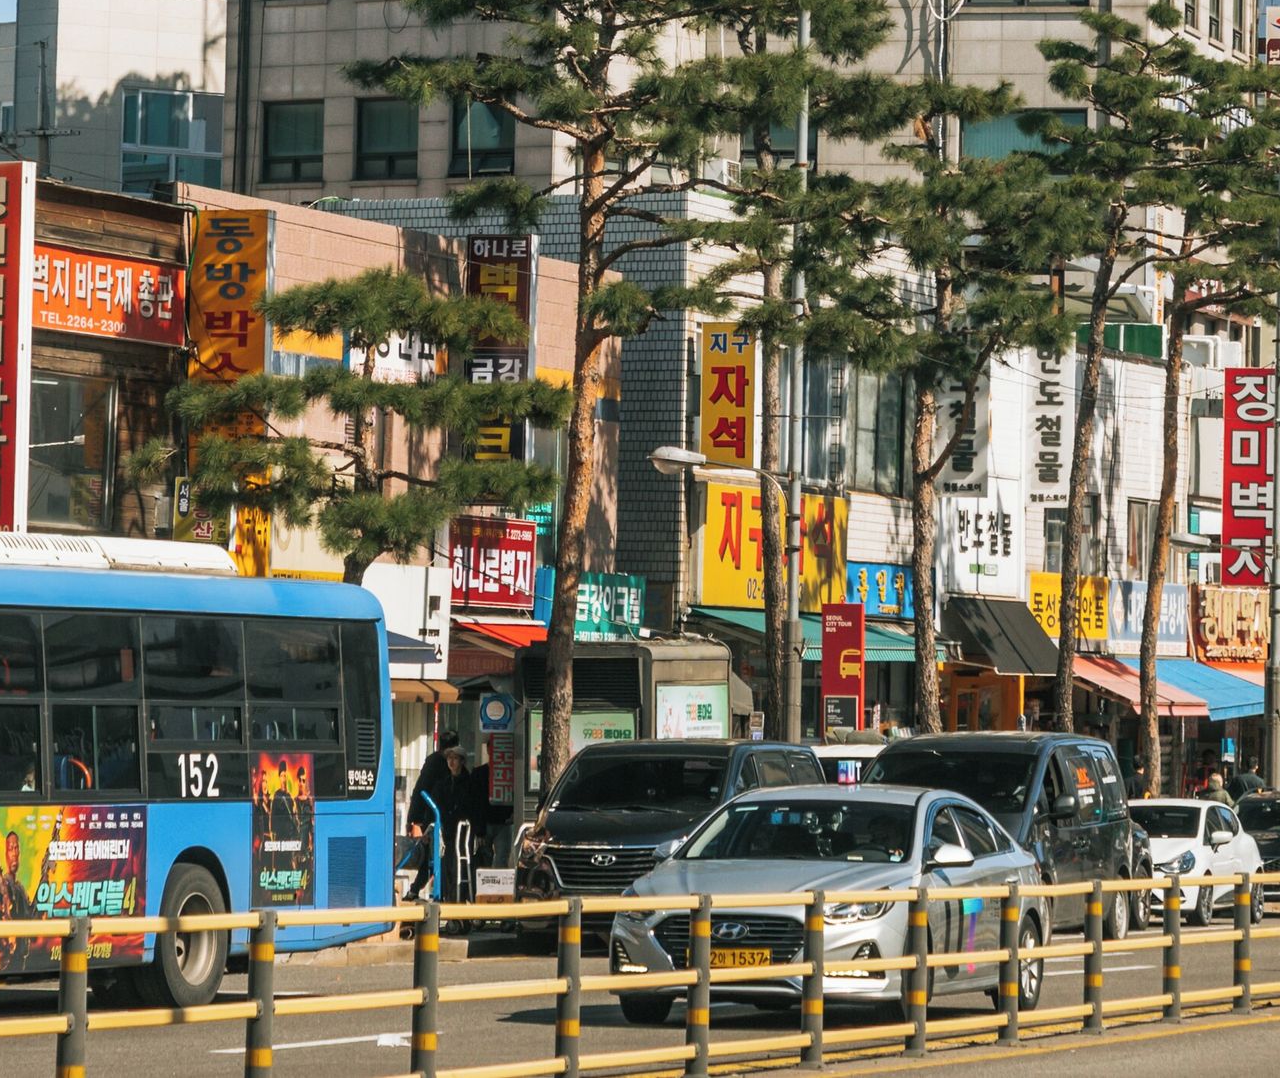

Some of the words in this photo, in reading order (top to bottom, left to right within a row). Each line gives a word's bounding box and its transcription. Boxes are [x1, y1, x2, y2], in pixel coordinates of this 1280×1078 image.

[473, 239, 527, 259] 하나로
[75, 260, 133, 315] 바닥재
[710, 332, 750, 355] 지구
[472, 358, 522, 384] 금강
[708, 365, 749, 459] 자석
[453, 545, 532, 596] 하나로벽지
[177, 753, 220, 798] 152
[731, 950, 765, 967] 1537
